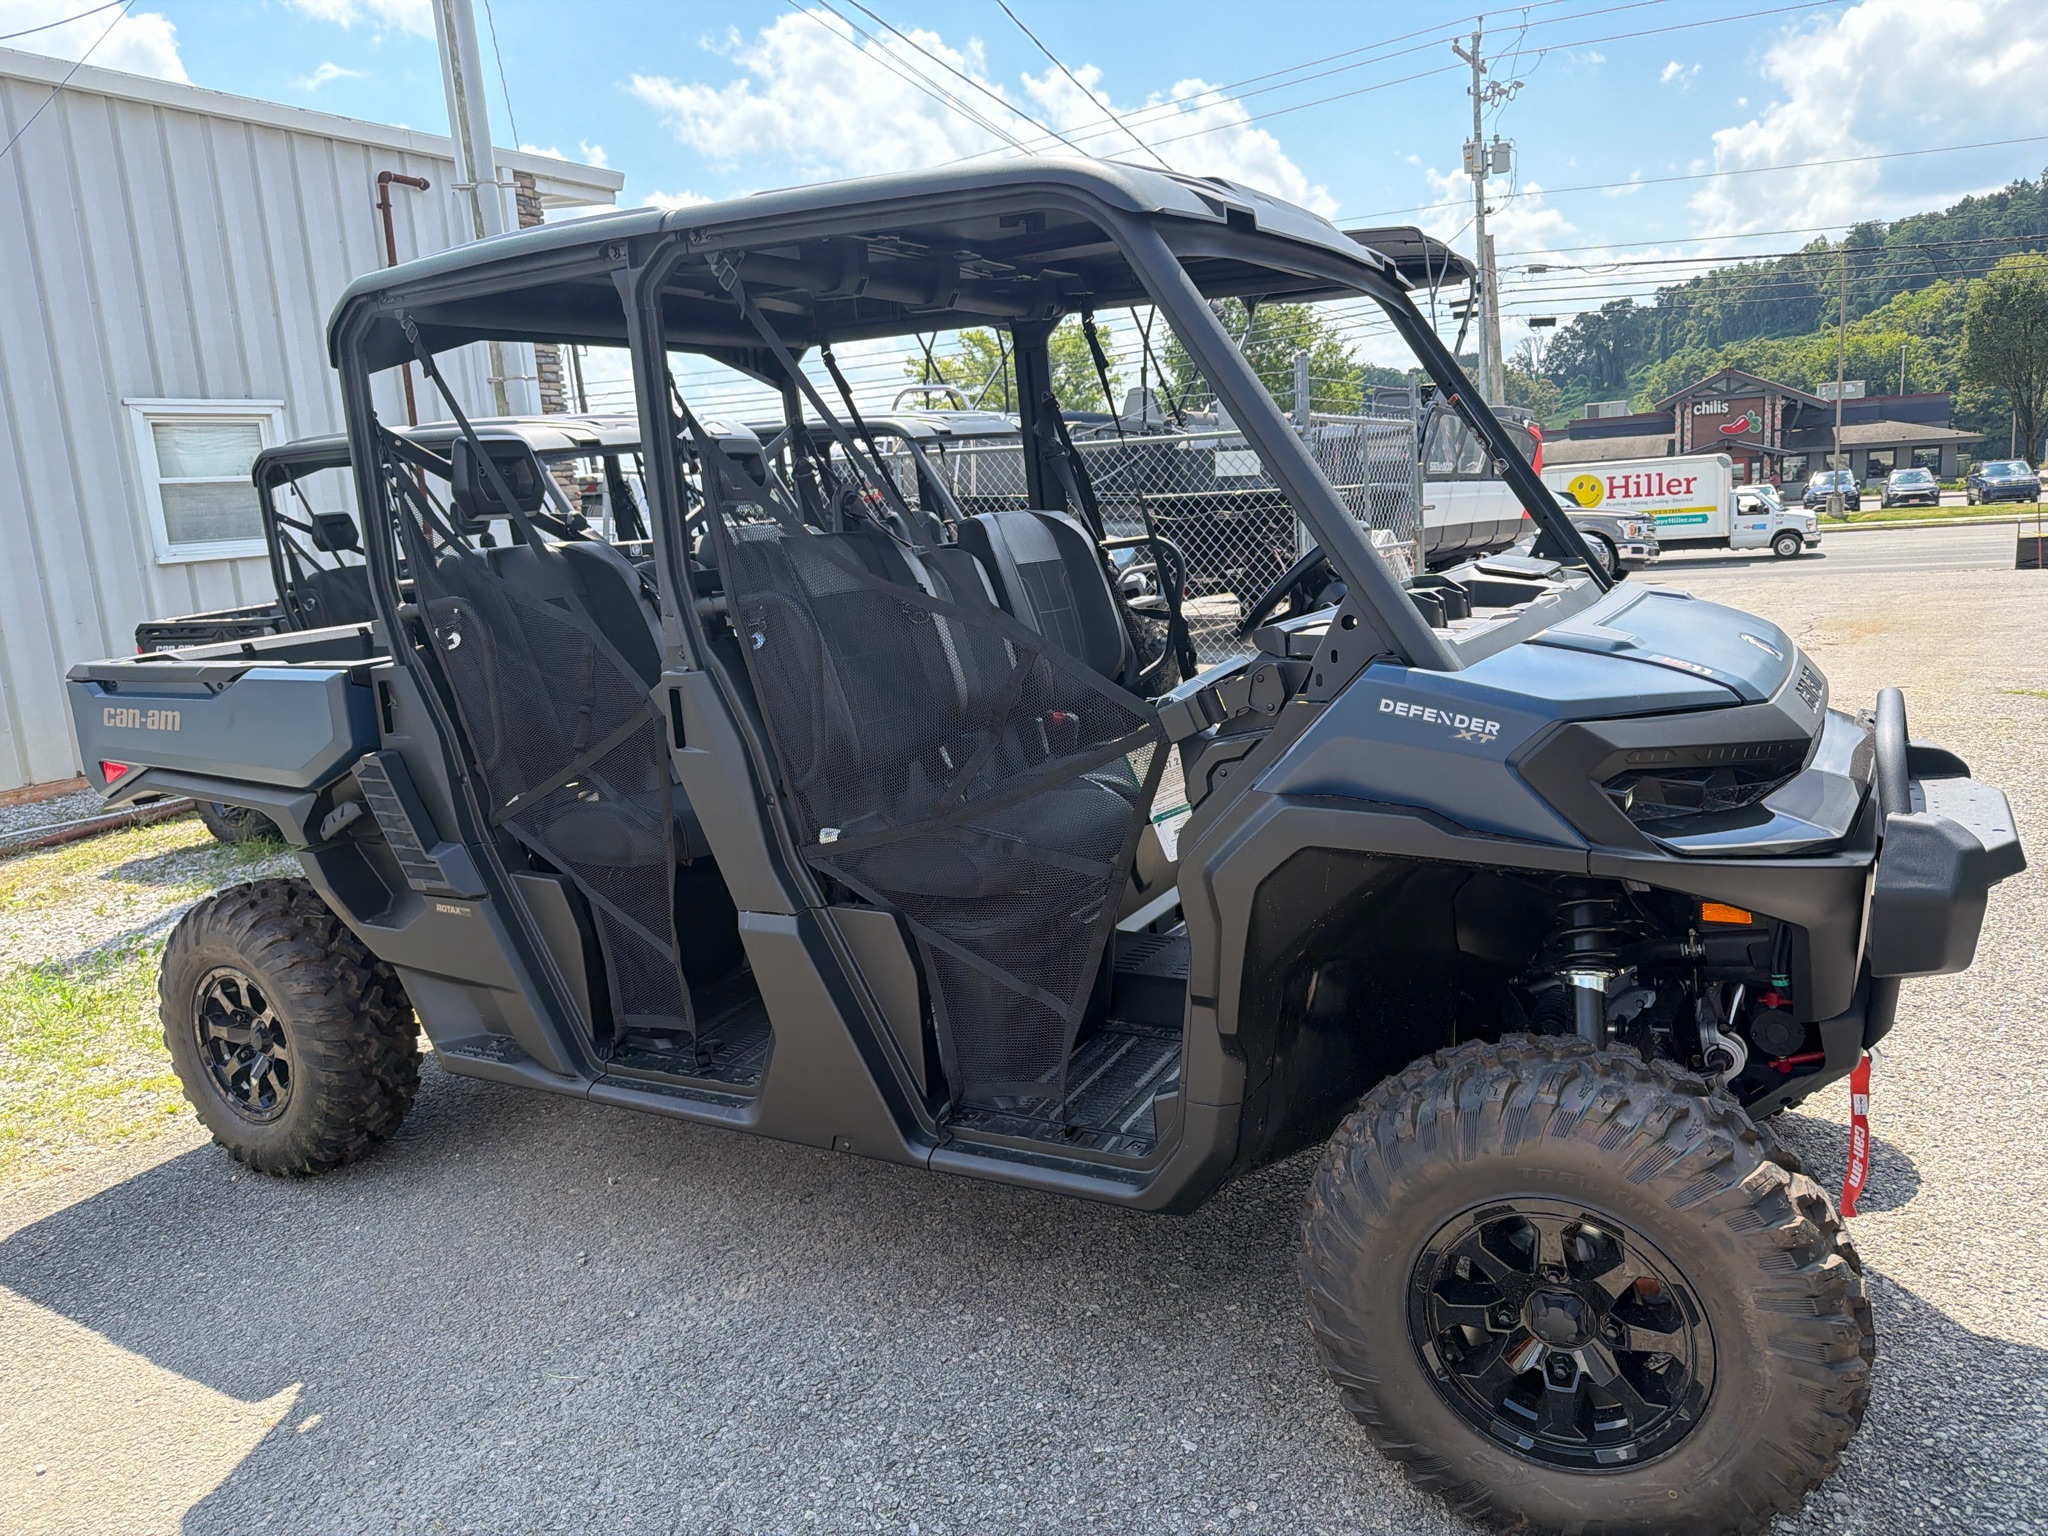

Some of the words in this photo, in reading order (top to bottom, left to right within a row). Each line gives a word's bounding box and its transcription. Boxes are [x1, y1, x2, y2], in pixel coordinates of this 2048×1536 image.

[1606, 472, 1698, 499] Hiller
[1655, 517, 1703, 525] ppyHiller.com
[103, 707, 181, 731] can-am
[1379, 698, 1500, 736] DEFENDER
[1453, 729, 1497, 744] XT
[436, 903, 462, 915] ROTAX
[1849, 1124, 1866, 1188] can-am
